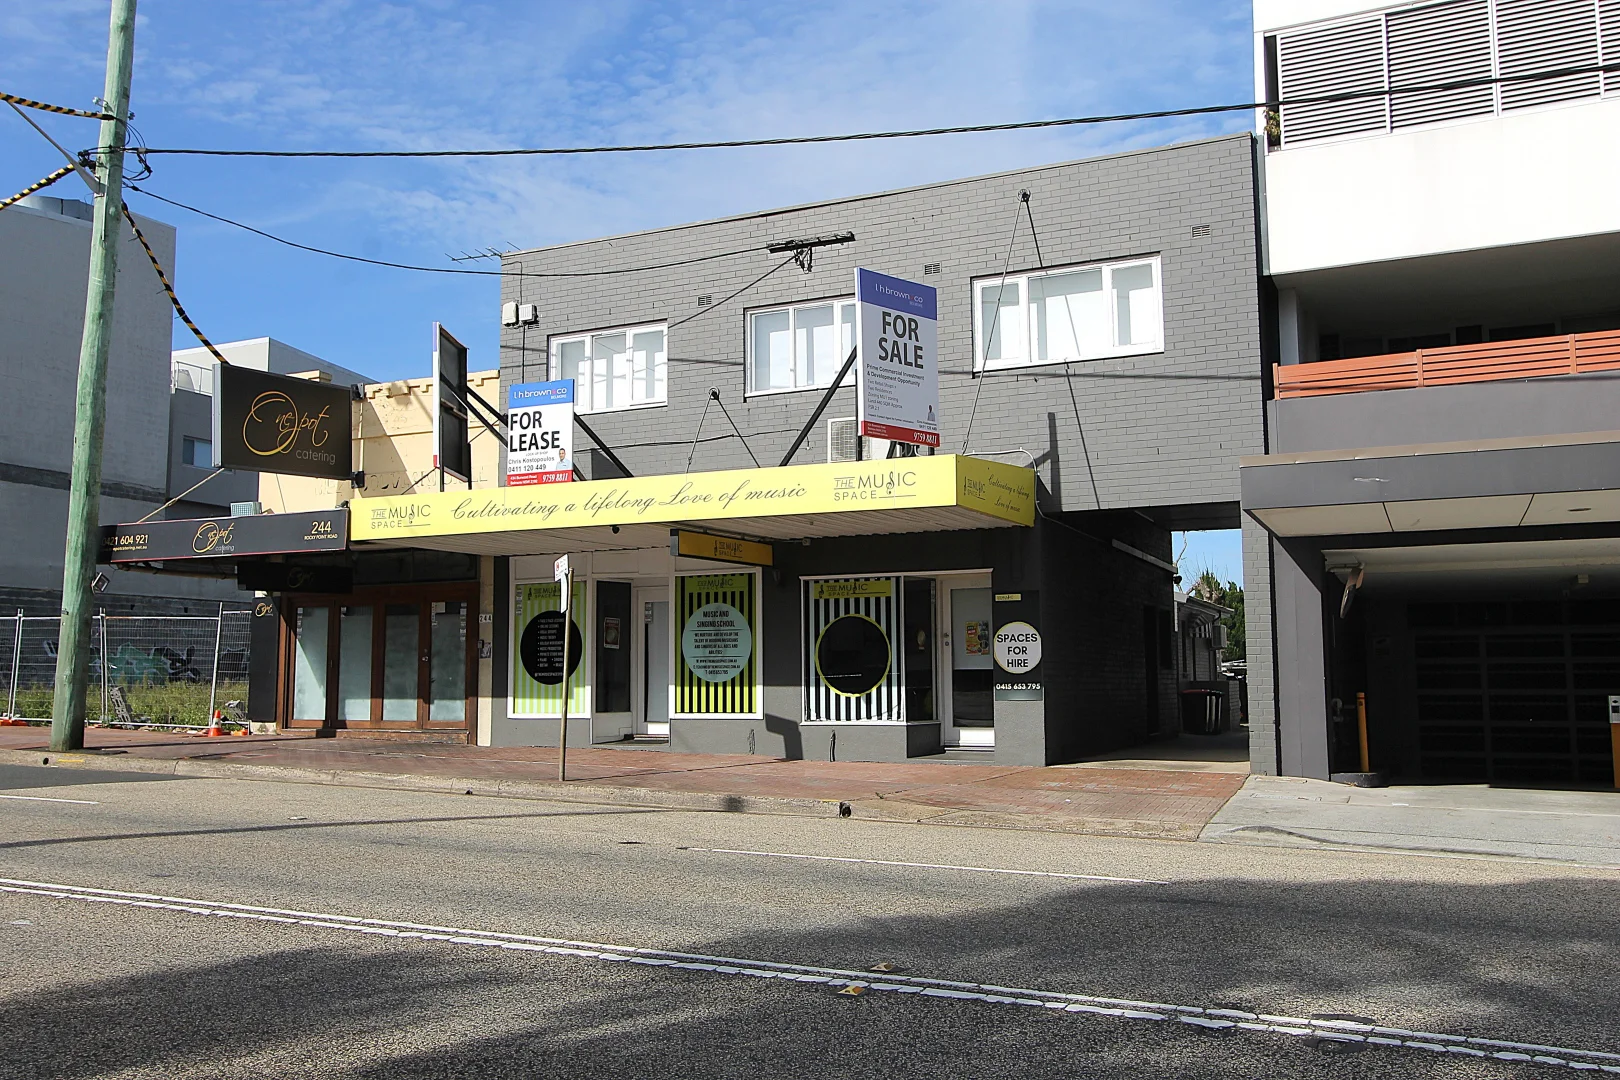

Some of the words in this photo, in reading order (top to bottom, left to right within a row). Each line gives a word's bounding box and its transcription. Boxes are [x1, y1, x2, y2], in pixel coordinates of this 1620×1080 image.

[881, 310, 919, 343] FOR
[878, 337, 924, 370] SALE
[866, 363, 878, 371] Prime
[879, 366, 902, 376] Commercial
[903, 371, 925, 381] Investment
[871, 371, 897, 381] Development
[897, 377, 921, 388] Opportunity
[510, 410, 542, 432] FOR
[509, 430, 560, 453] LEASE
[913, 431, 925, 442] 9759
[925, 434, 937, 445] 8811
[295, 449, 336, 465] catering
[522, 456, 555, 464] Kostopoulos
[542, 473, 555, 482] 9759
[555, 472, 568, 481] 8811
[834, 479, 855, 488] THE
[858, 471, 917, 493] MUSIC
[451, 497, 560, 521] Cultivating
[564, 503, 577, 512] a
[584, 489, 656, 518] lifelong
[658, 482, 713, 506] Love
[719, 480, 750, 509] of
[745, 483, 807, 500] music
[834, 490, 877, 501] SPACE
[371, 509, 387, 519] THE
[388, 504, 432, 522] MUSIC
[311, 520, 332, 534] 244
[371, 520, 403, 529] SPACE
[119, 535, 134, 545] 604
[135, 534, 149, 544] 921
[707, 578, 734, 588] MUSIC
[838, 582, 868, 593] MUSIC
[696, 620, 717, 628] SINGING
[996, 633, 1038, 643] SPACES
[1007, 646, 1028, 656] FOR
[1006, 658, 1029, 668] HIRE
